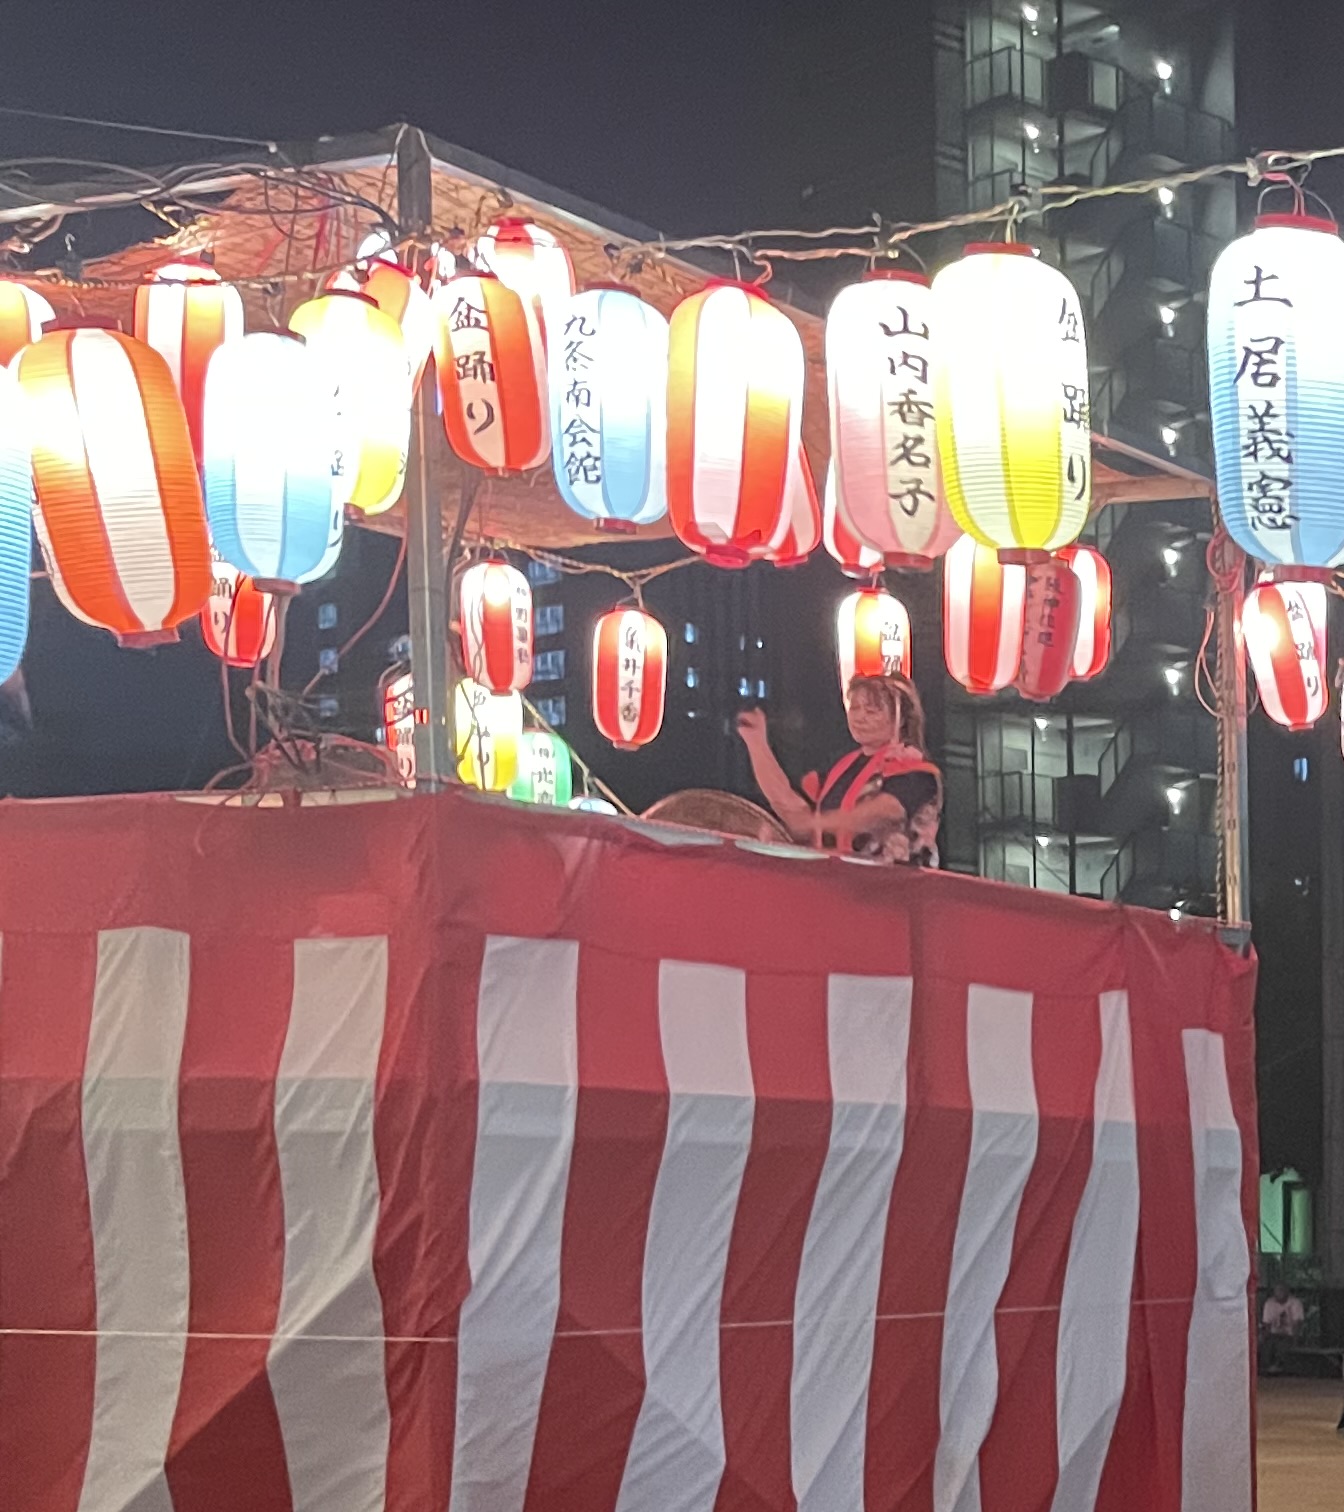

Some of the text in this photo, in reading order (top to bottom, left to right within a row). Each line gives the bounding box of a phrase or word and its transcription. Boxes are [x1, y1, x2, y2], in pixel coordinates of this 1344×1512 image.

[448, 296, 497, 435] 盆踊り
[879, 305, 936, 518] 山内香名子
